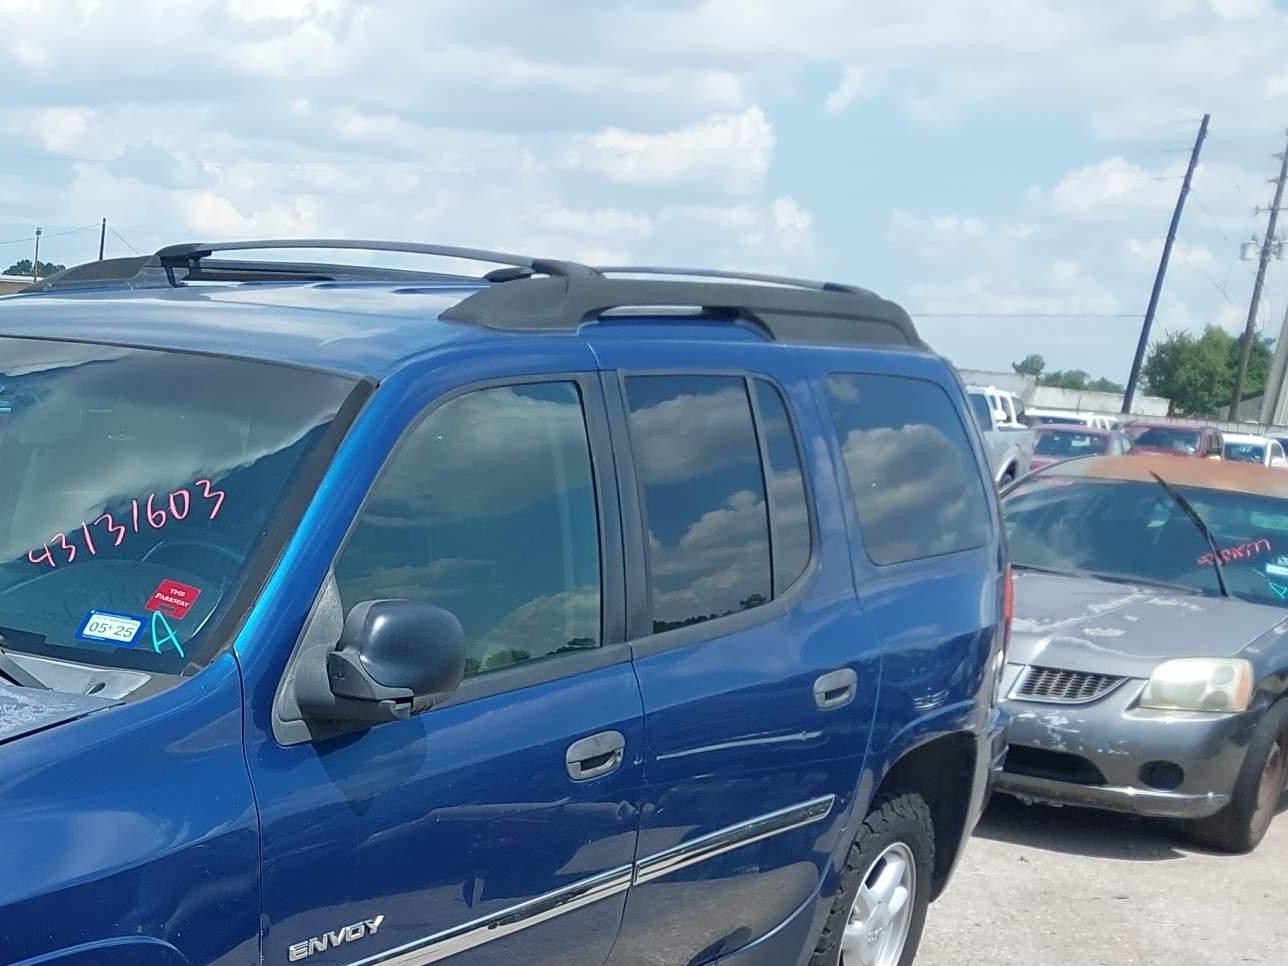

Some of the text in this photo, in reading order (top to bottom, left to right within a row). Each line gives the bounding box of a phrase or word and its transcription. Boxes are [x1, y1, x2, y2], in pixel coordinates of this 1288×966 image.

[28, 479, 226, 567] 43131603
[154, 592, 191, 608] PARKWAY
[169, 588, 186, 597] THE
[88, 621, 134, 638] 05 25
[151, 610, 185, 658] A
[288, 914, 385, 962] ENVOY
